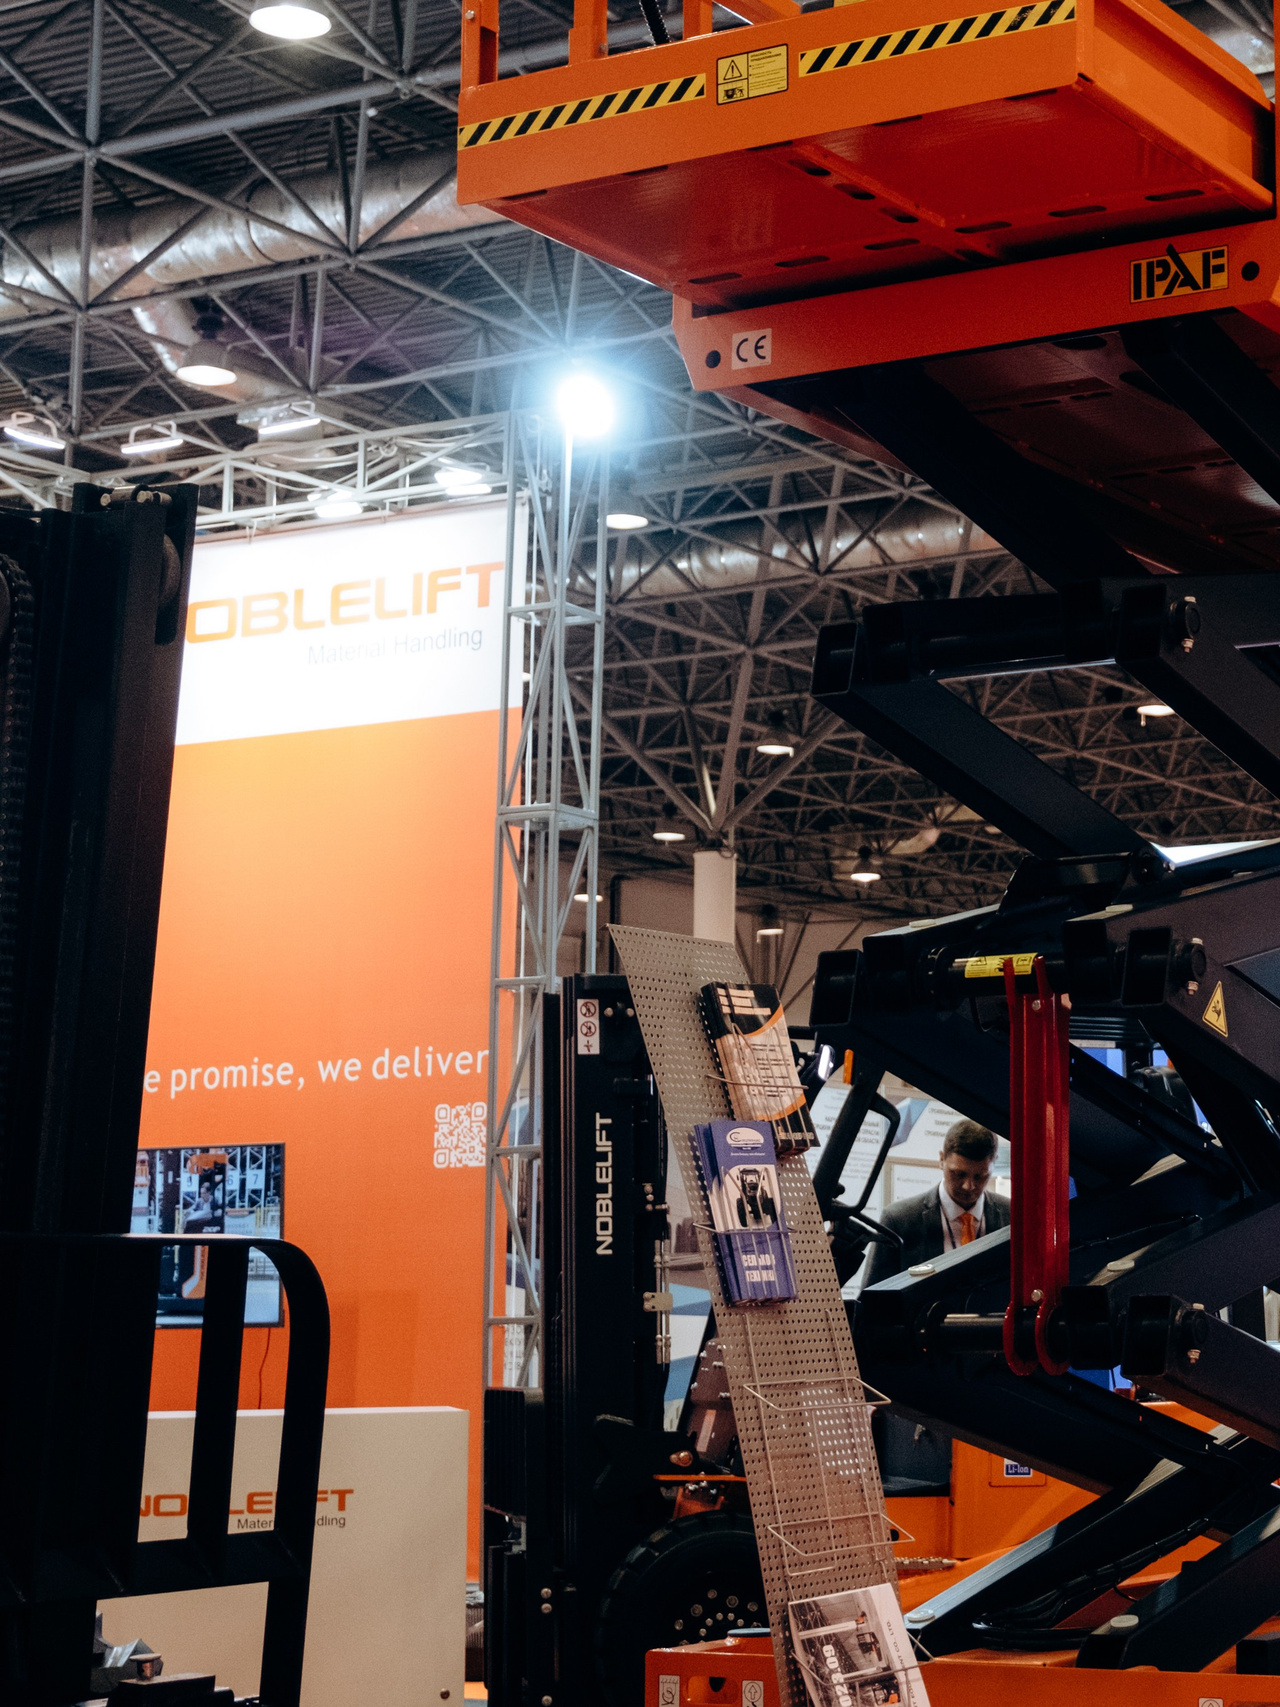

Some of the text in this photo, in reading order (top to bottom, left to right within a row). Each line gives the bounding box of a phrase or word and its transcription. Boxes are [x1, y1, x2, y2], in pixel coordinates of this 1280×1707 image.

[1133, 243, 1225, 300] IPAF
[736, 335, 767, 362] CE
[185, 561, 505, 644] OBLELIFT
[308, 627, 483, 666] Material Handling
[144, 1046, 490, 1100] e promise, we deliver
[252, 1173, 259, 1186] 7
[596, 1112, 613, 1255] NOBLELIFT
